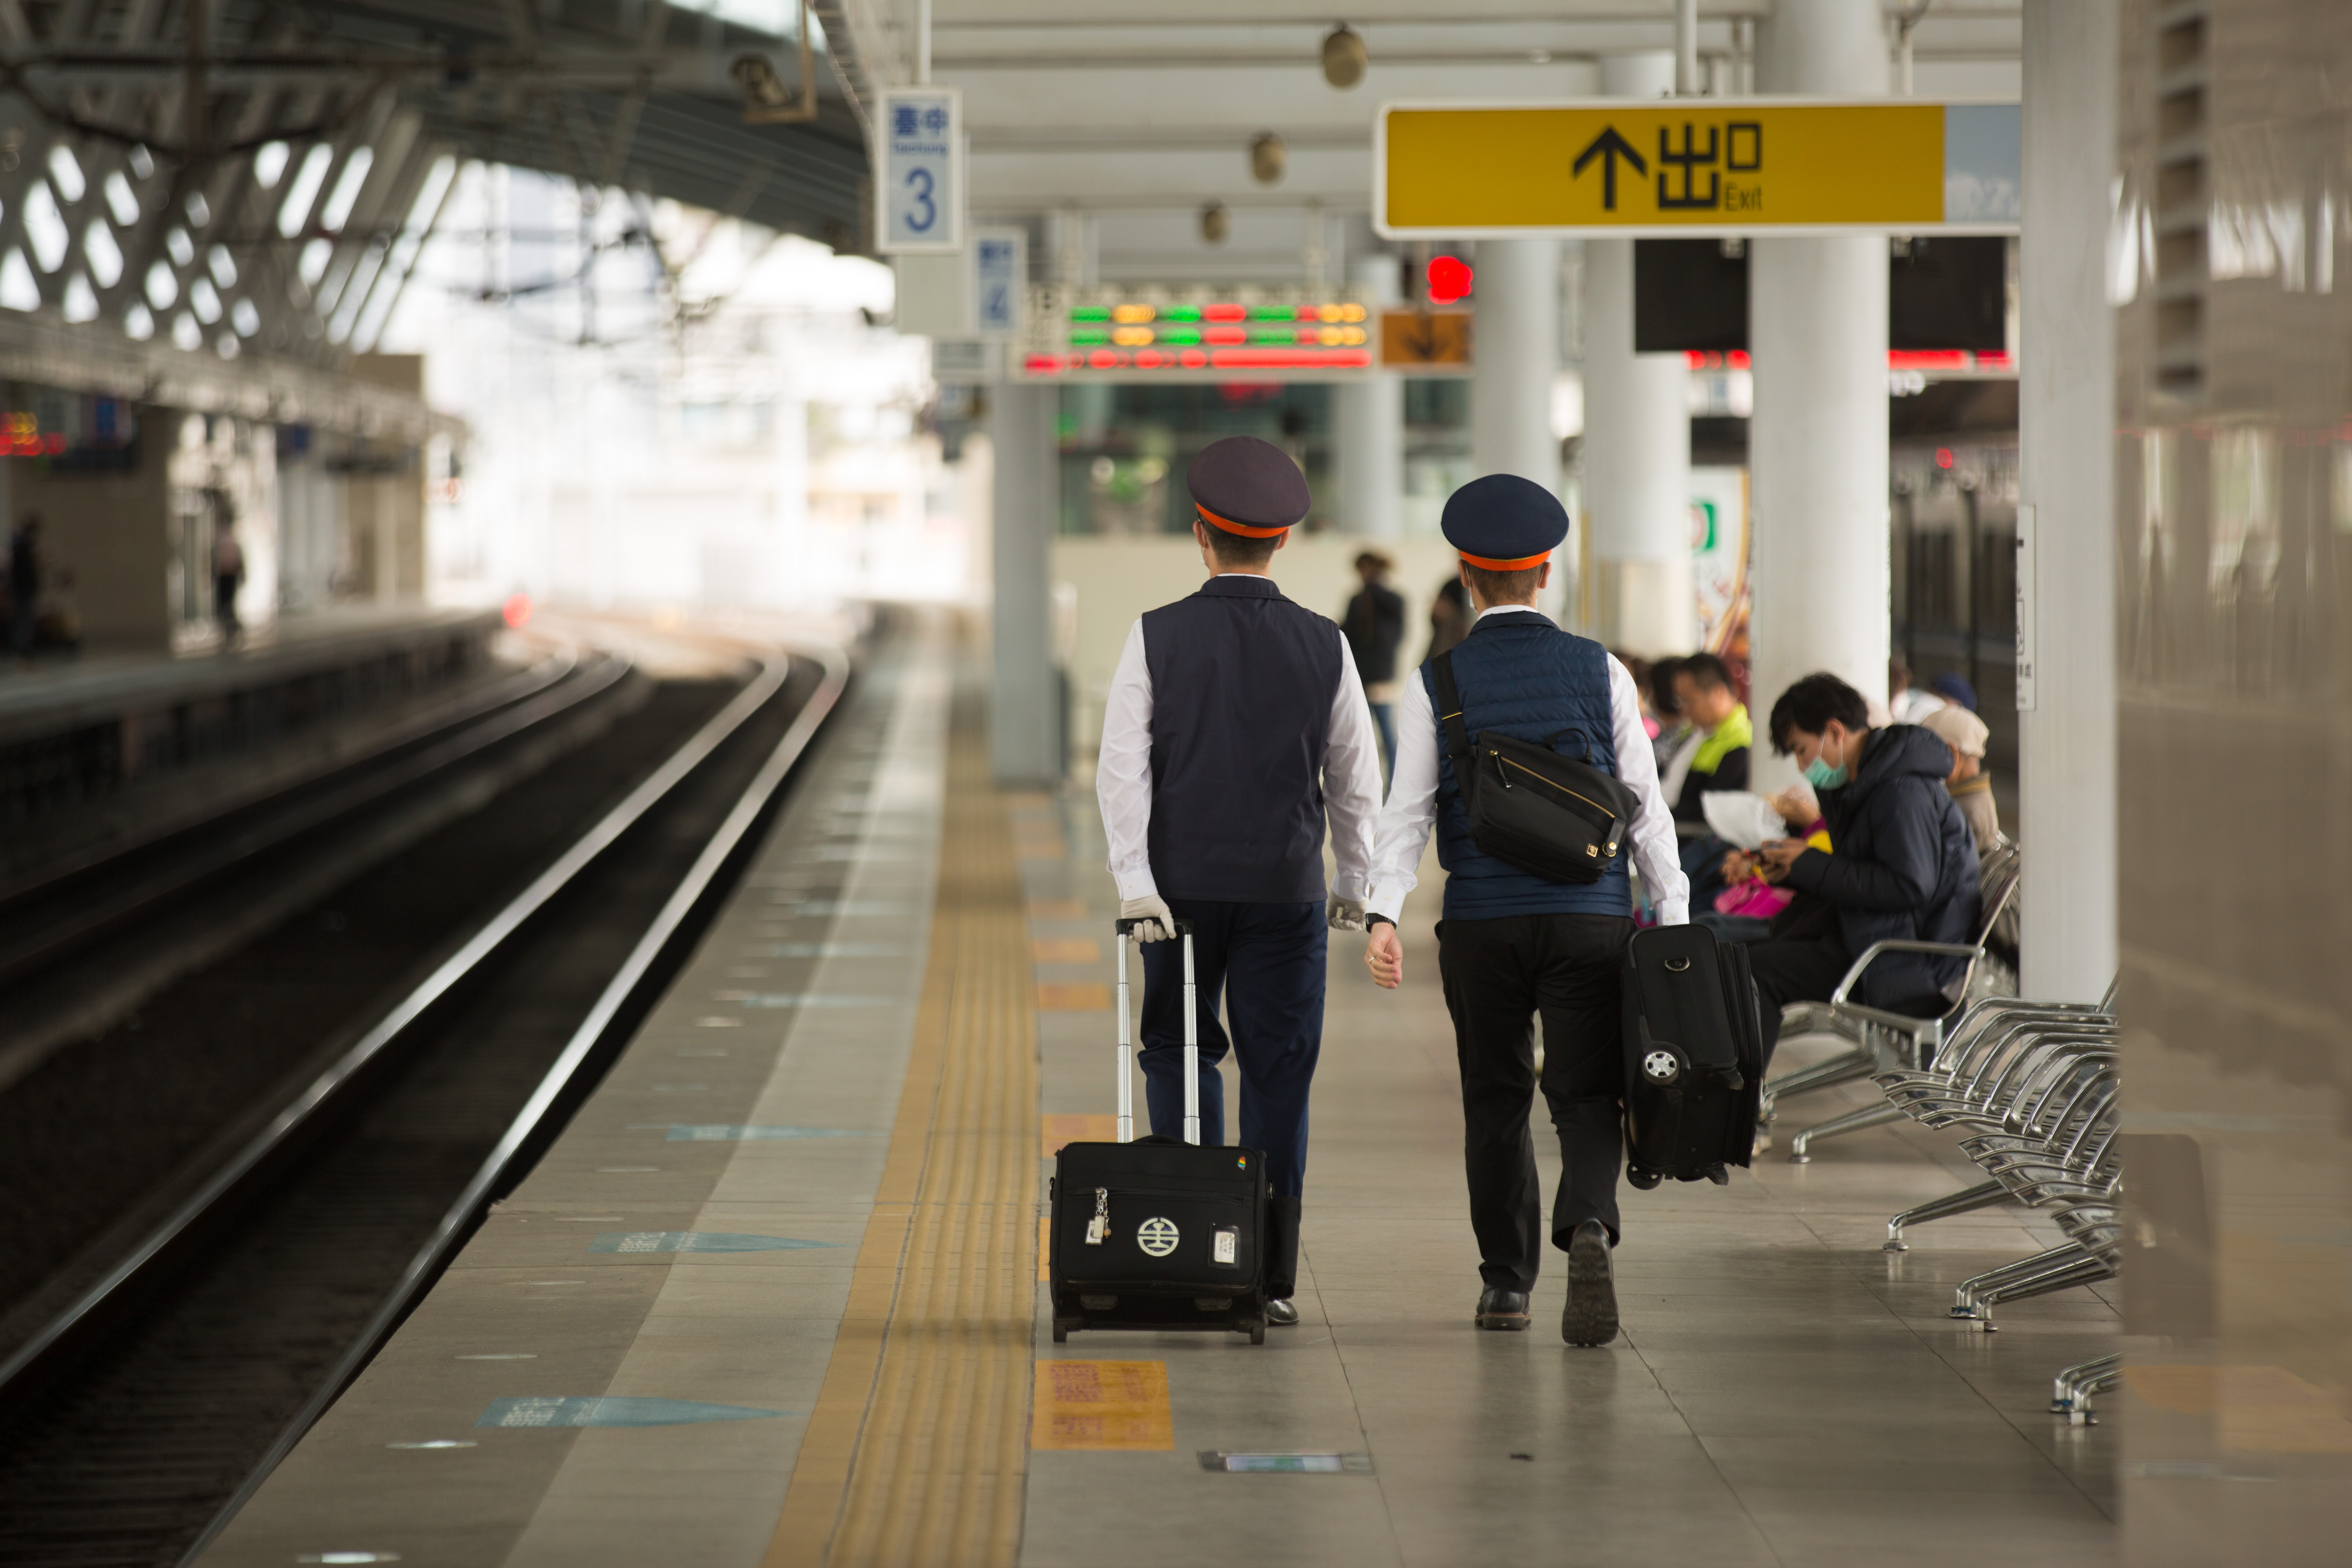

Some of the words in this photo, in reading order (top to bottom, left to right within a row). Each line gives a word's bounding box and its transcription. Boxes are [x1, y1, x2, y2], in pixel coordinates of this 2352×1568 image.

[1658, 122, 1762, 211] 出口
[1725, 183, 1762, 212] Exit
[904, 167, 937, 234] 3
